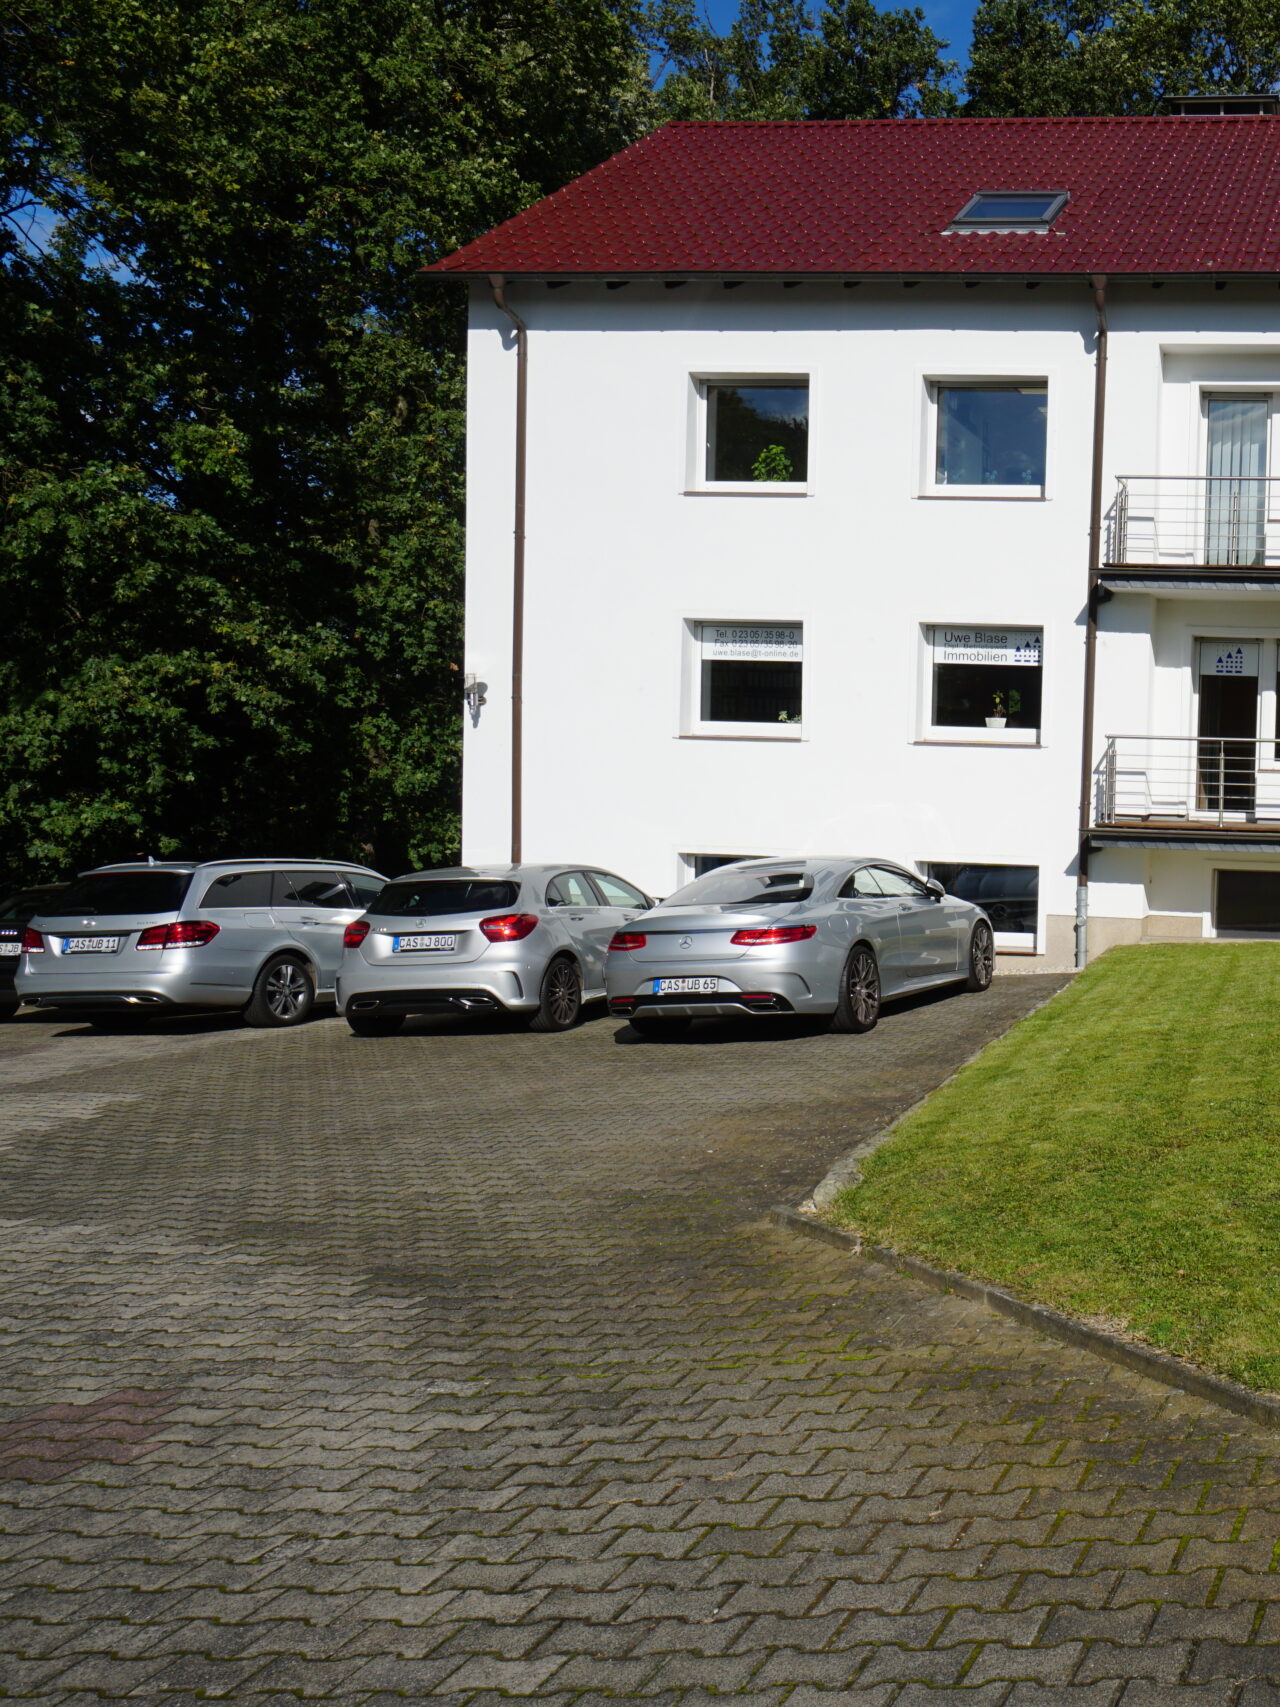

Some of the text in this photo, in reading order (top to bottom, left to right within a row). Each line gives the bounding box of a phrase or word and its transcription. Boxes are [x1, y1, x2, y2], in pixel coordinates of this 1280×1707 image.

[944, 631, 1008, 644] Uwe Blase
[944, 650, 1008, 662] Immobilien
[68, 938, 86, 950] CAS
[400, 938, 418, 949] CAS
[660, 979, 716, 991] CAS UB 65
